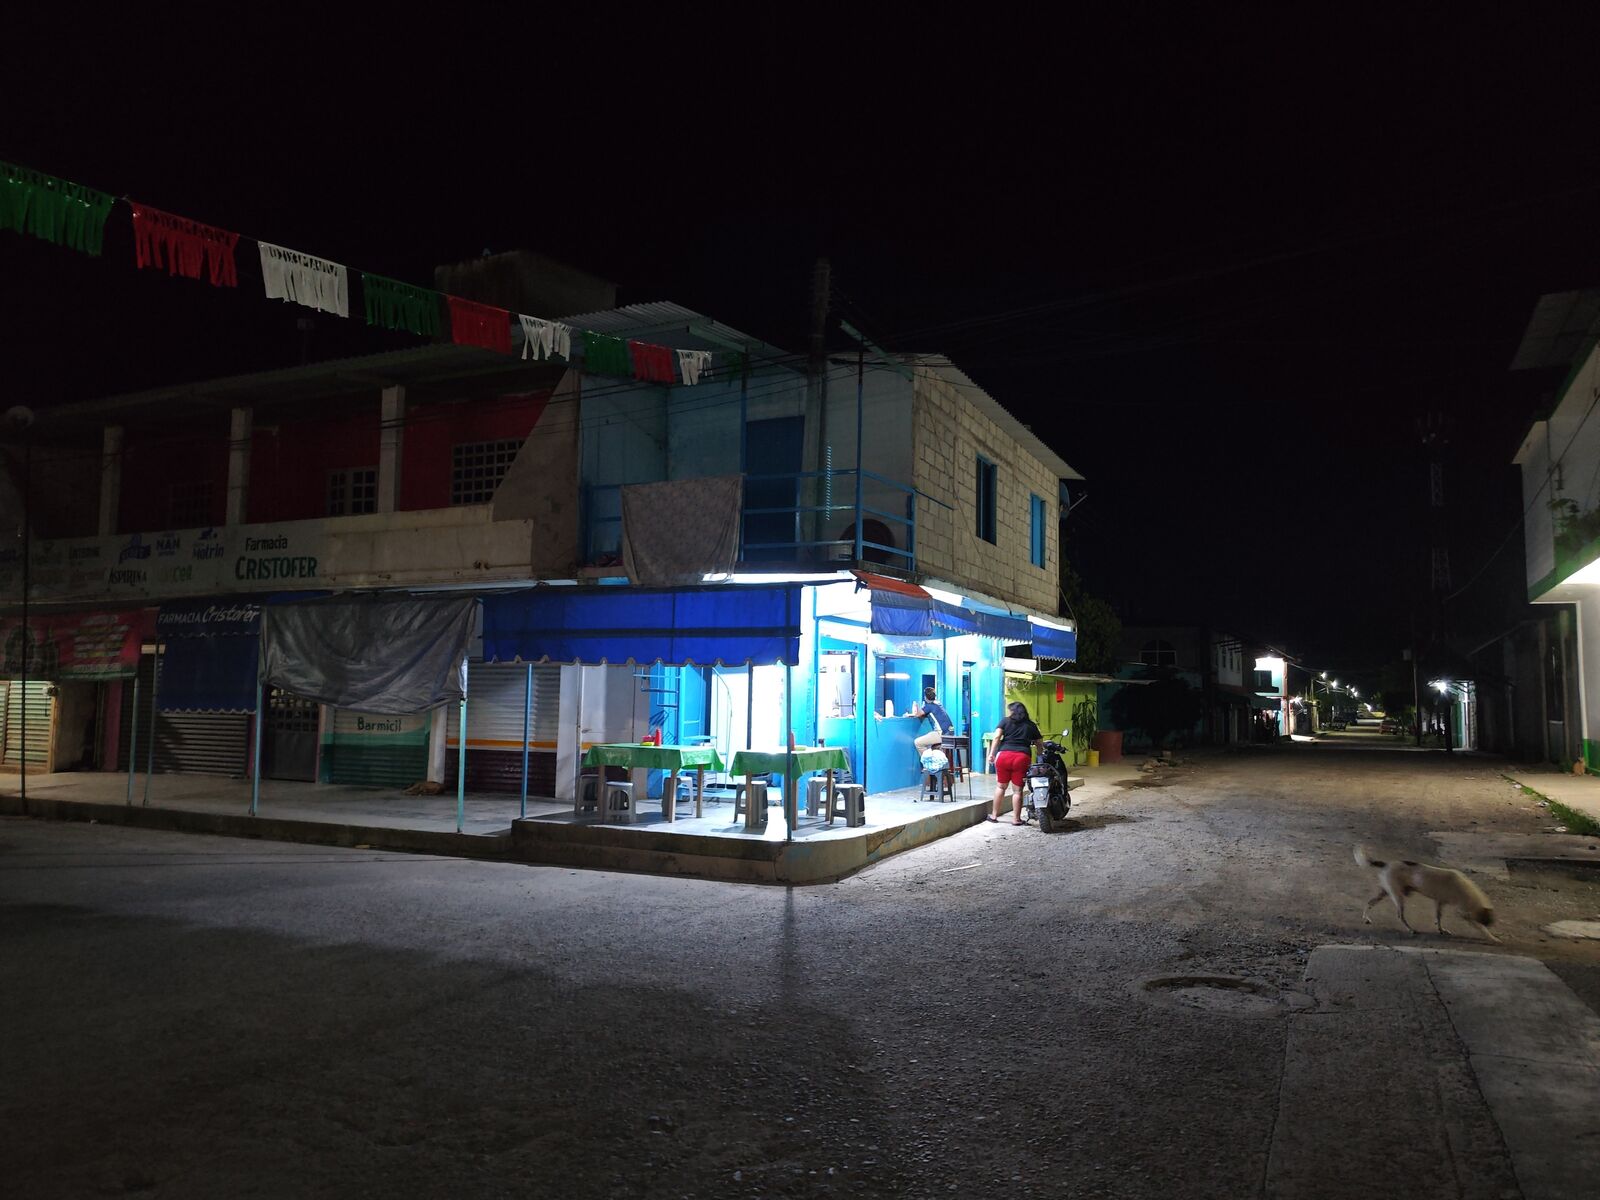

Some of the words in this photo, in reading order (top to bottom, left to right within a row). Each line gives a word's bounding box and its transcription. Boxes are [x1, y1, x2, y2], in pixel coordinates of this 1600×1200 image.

[245, 534, 289, 552] Farmacia
[235, 555, 318, 580] CRISTOFER
[157, 611, 201, 624] FARMACIA
[357, 716, 402, 732] Barmicil
